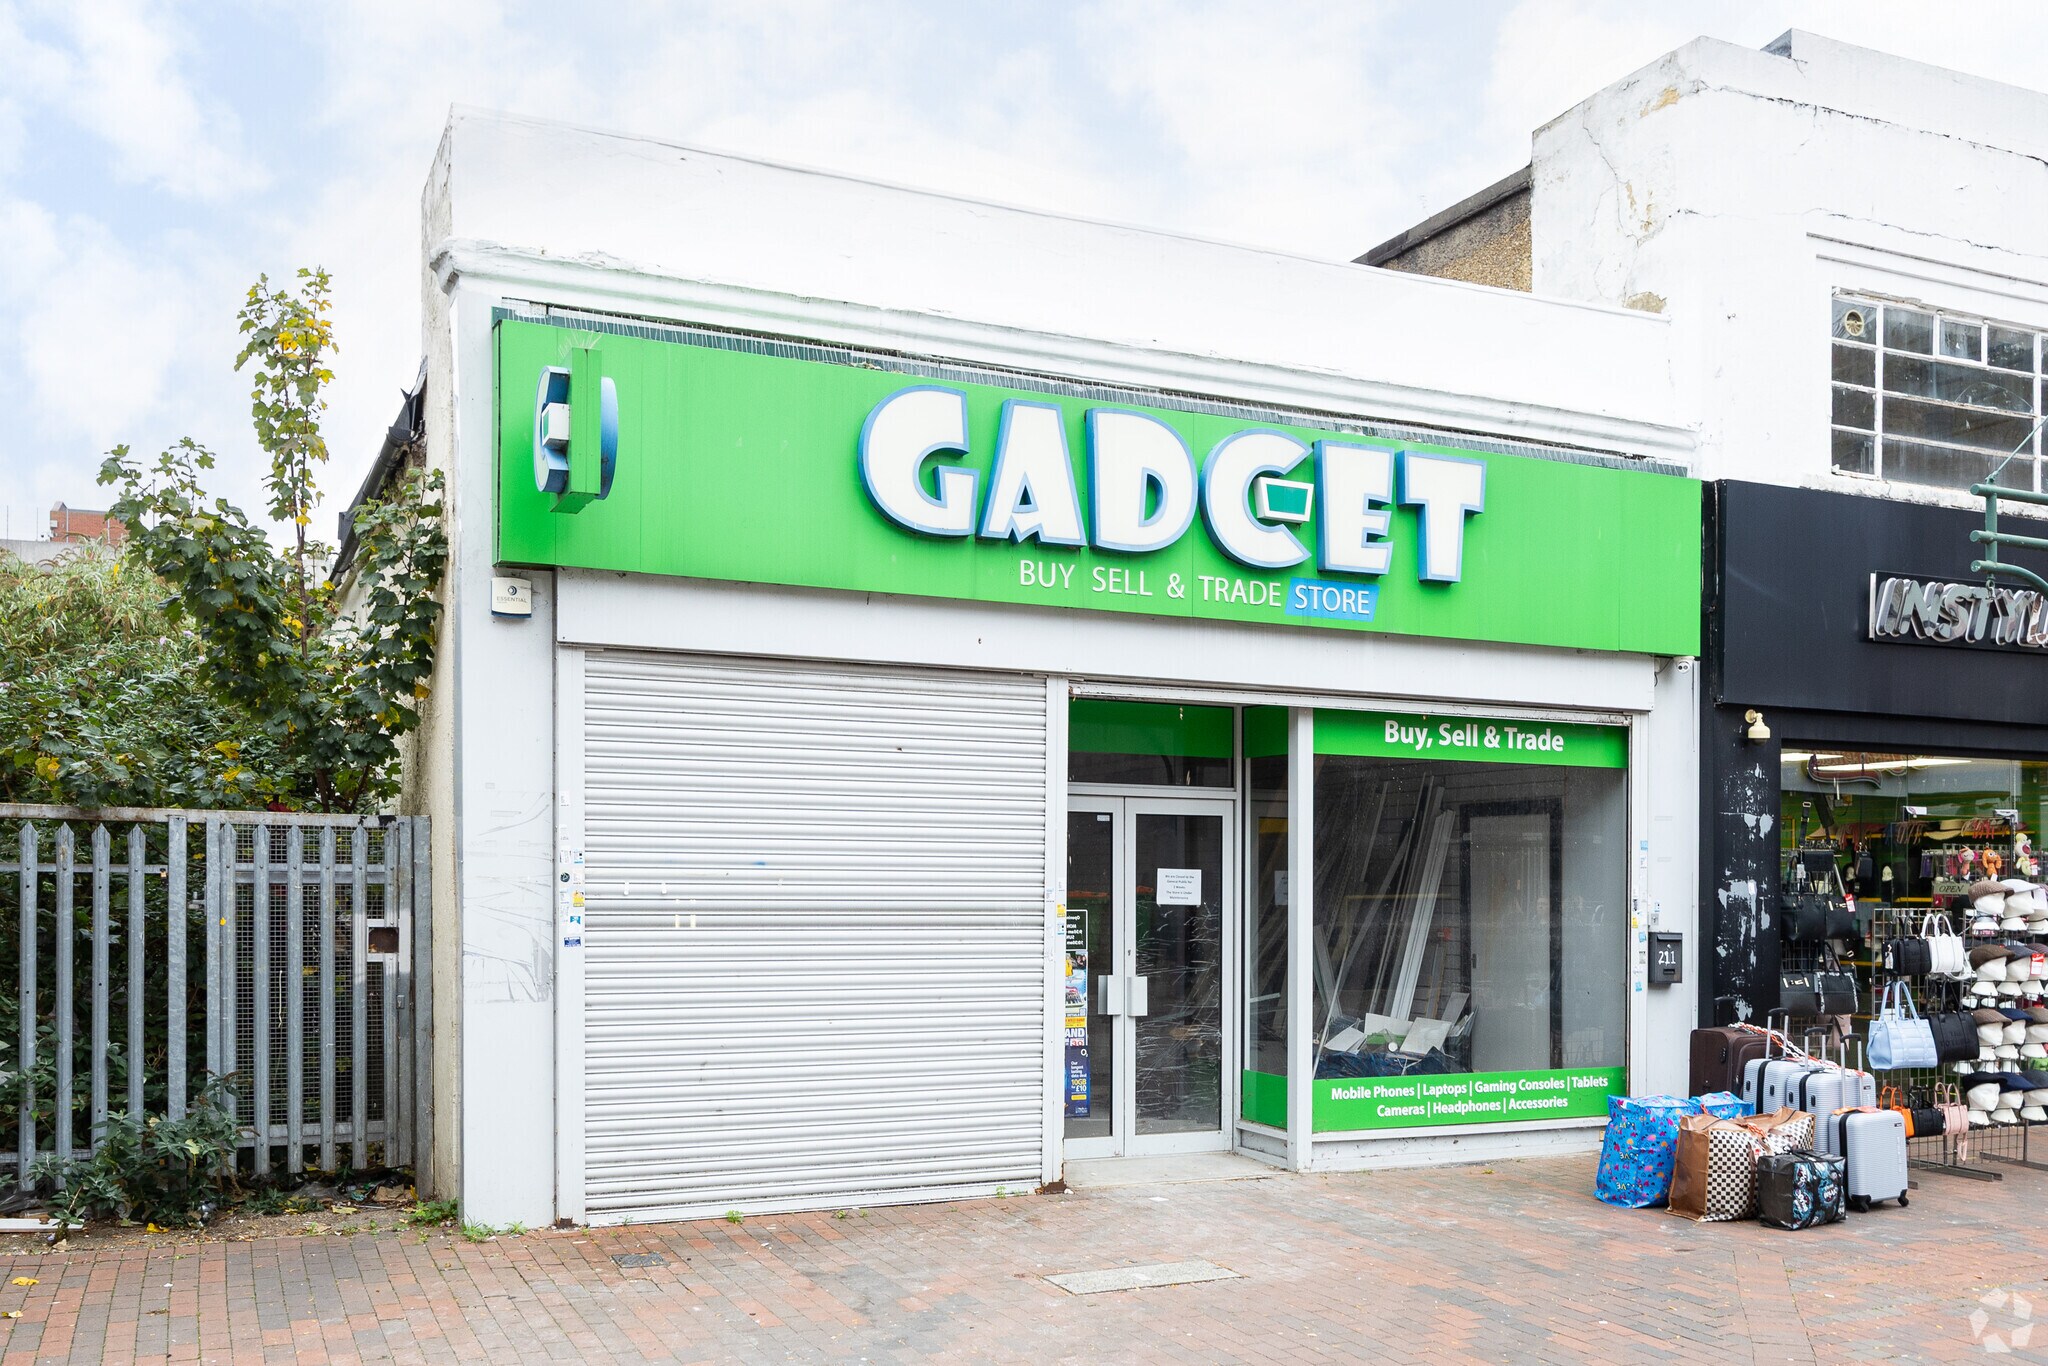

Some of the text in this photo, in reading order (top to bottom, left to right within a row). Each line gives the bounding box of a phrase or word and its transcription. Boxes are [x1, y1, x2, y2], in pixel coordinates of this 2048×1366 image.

[857, 384, 1487, 584] GADGET
[1019, 559, 1370, 614] BUY SELL & TRADE STORE
[1876, 577, 2048, 648] INSTYL
[1384, 720, 1564, 751] Buy, Sell & Trade
[1939, 884, 1964, 893] OPEN
[1657, 950, 1676, 966] 211
[1331, 1087, 1371, 1100] Mobile
[1373, 1085, 1415, 1098] Phones
[1423, 1083, 1467, 1098] Laptops
[1474, 1080, 1516, 1094] Gaming
[1518, 1077, 1565, 1091] Consoles
[1571, 1075, 1608, 1088] Tablets
[1377, 1104, 1425, 1117] Cameras
[1433, 1099, 1501, 1115] Headphones
[1508, 1096, 1568, 1110] Accessories
